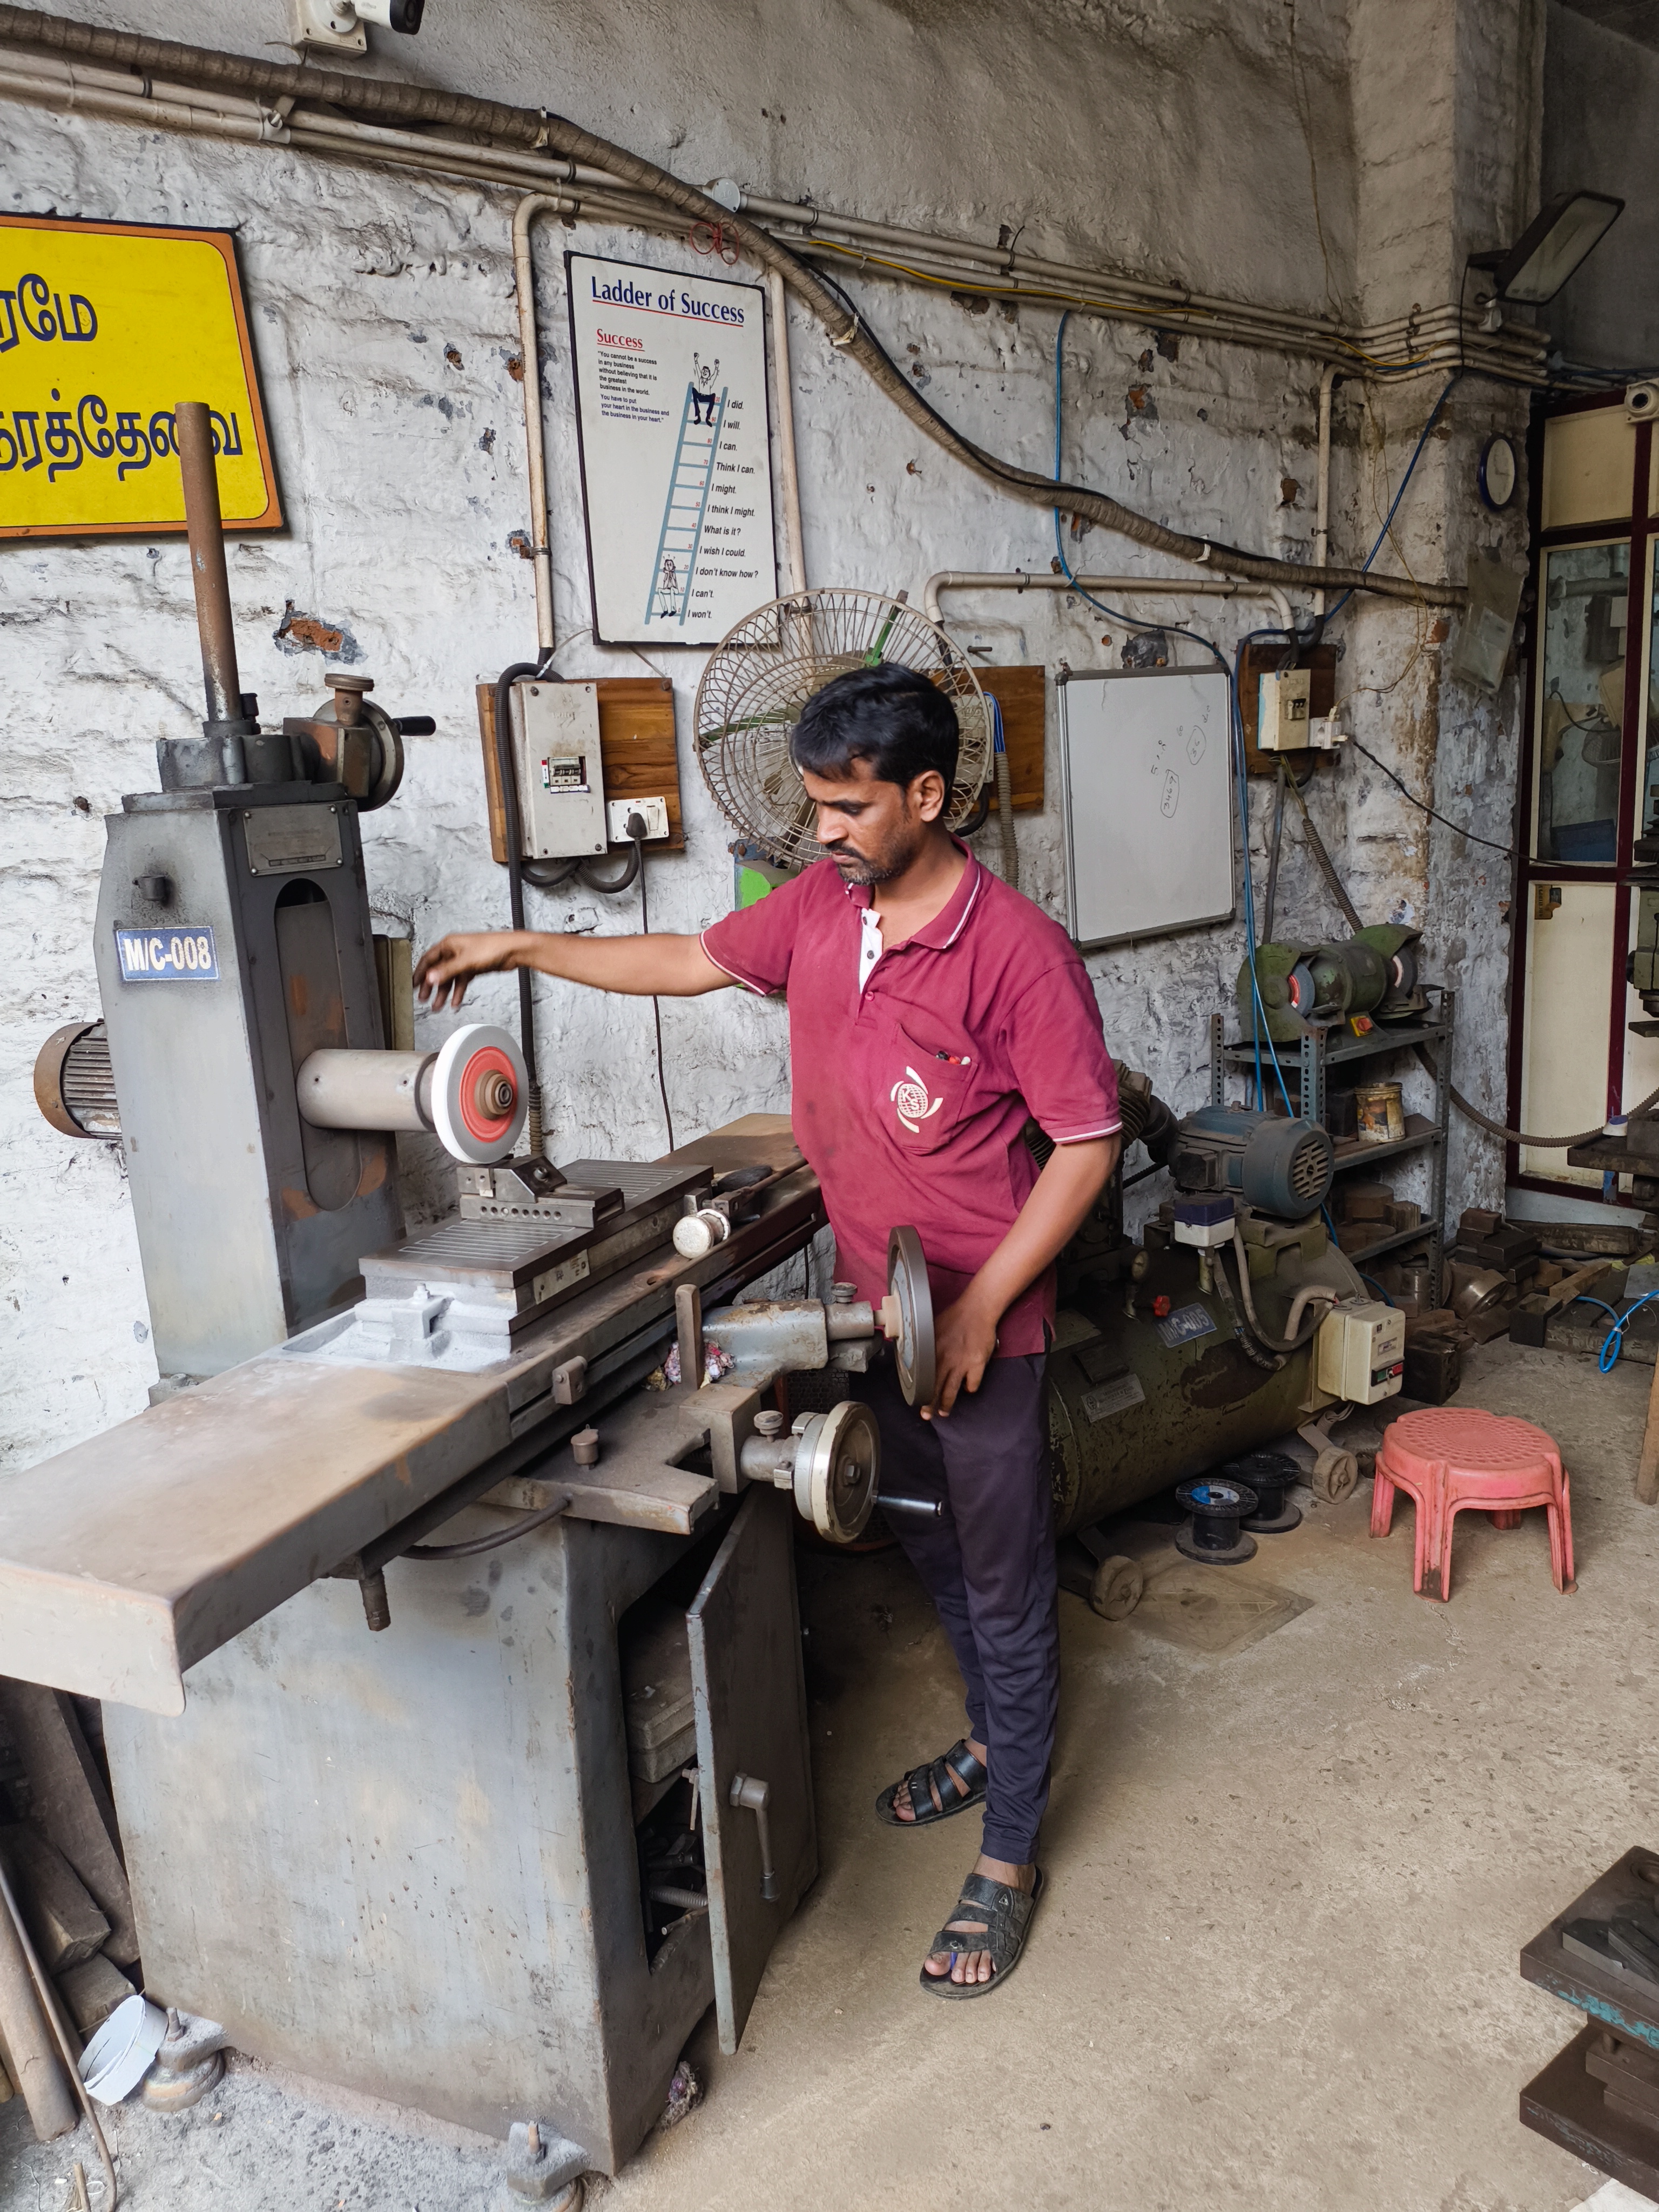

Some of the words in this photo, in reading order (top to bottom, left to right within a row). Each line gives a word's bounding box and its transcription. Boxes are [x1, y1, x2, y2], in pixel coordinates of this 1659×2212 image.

[591, 276, 652, 307] Ladder
[658, 289, 675, 311] of
[681, 293, 745, 323] Success
[597, 328, 643, 348] Success
[613, 361, 635, 369] business
[638, 357, 657, 365] success
[617, 370, 638, 379] believing
[599, 383, 621, 391] business
[727, 400, 730, 408] I
[731, 401, 744, 409] did.
[639, 407, 659, 415] business
[723, 420, 726, 428] I
[727, 421, 740, 430] will.
[723, 443, 737, 451] can.
[717, 462, 736, 472] Think
[711, 483, 714, 491] I
[716, 484, 737, 495] might.
[712, 505, 729, 514] think
[734, 508, 756, 517] might.
[704, 525, 722, 534] What
[723, 527, 730, 535] is
[704, 547, 720, 555] wish
[725, 549, 746, 557] could.
[700, 567, 718, 576] don't
[719, 568, 737, 577] know
[691, 589, 694, 597] I
[696, 590, 714, 598] can't.
[692, 610, 712, 618] won't.
